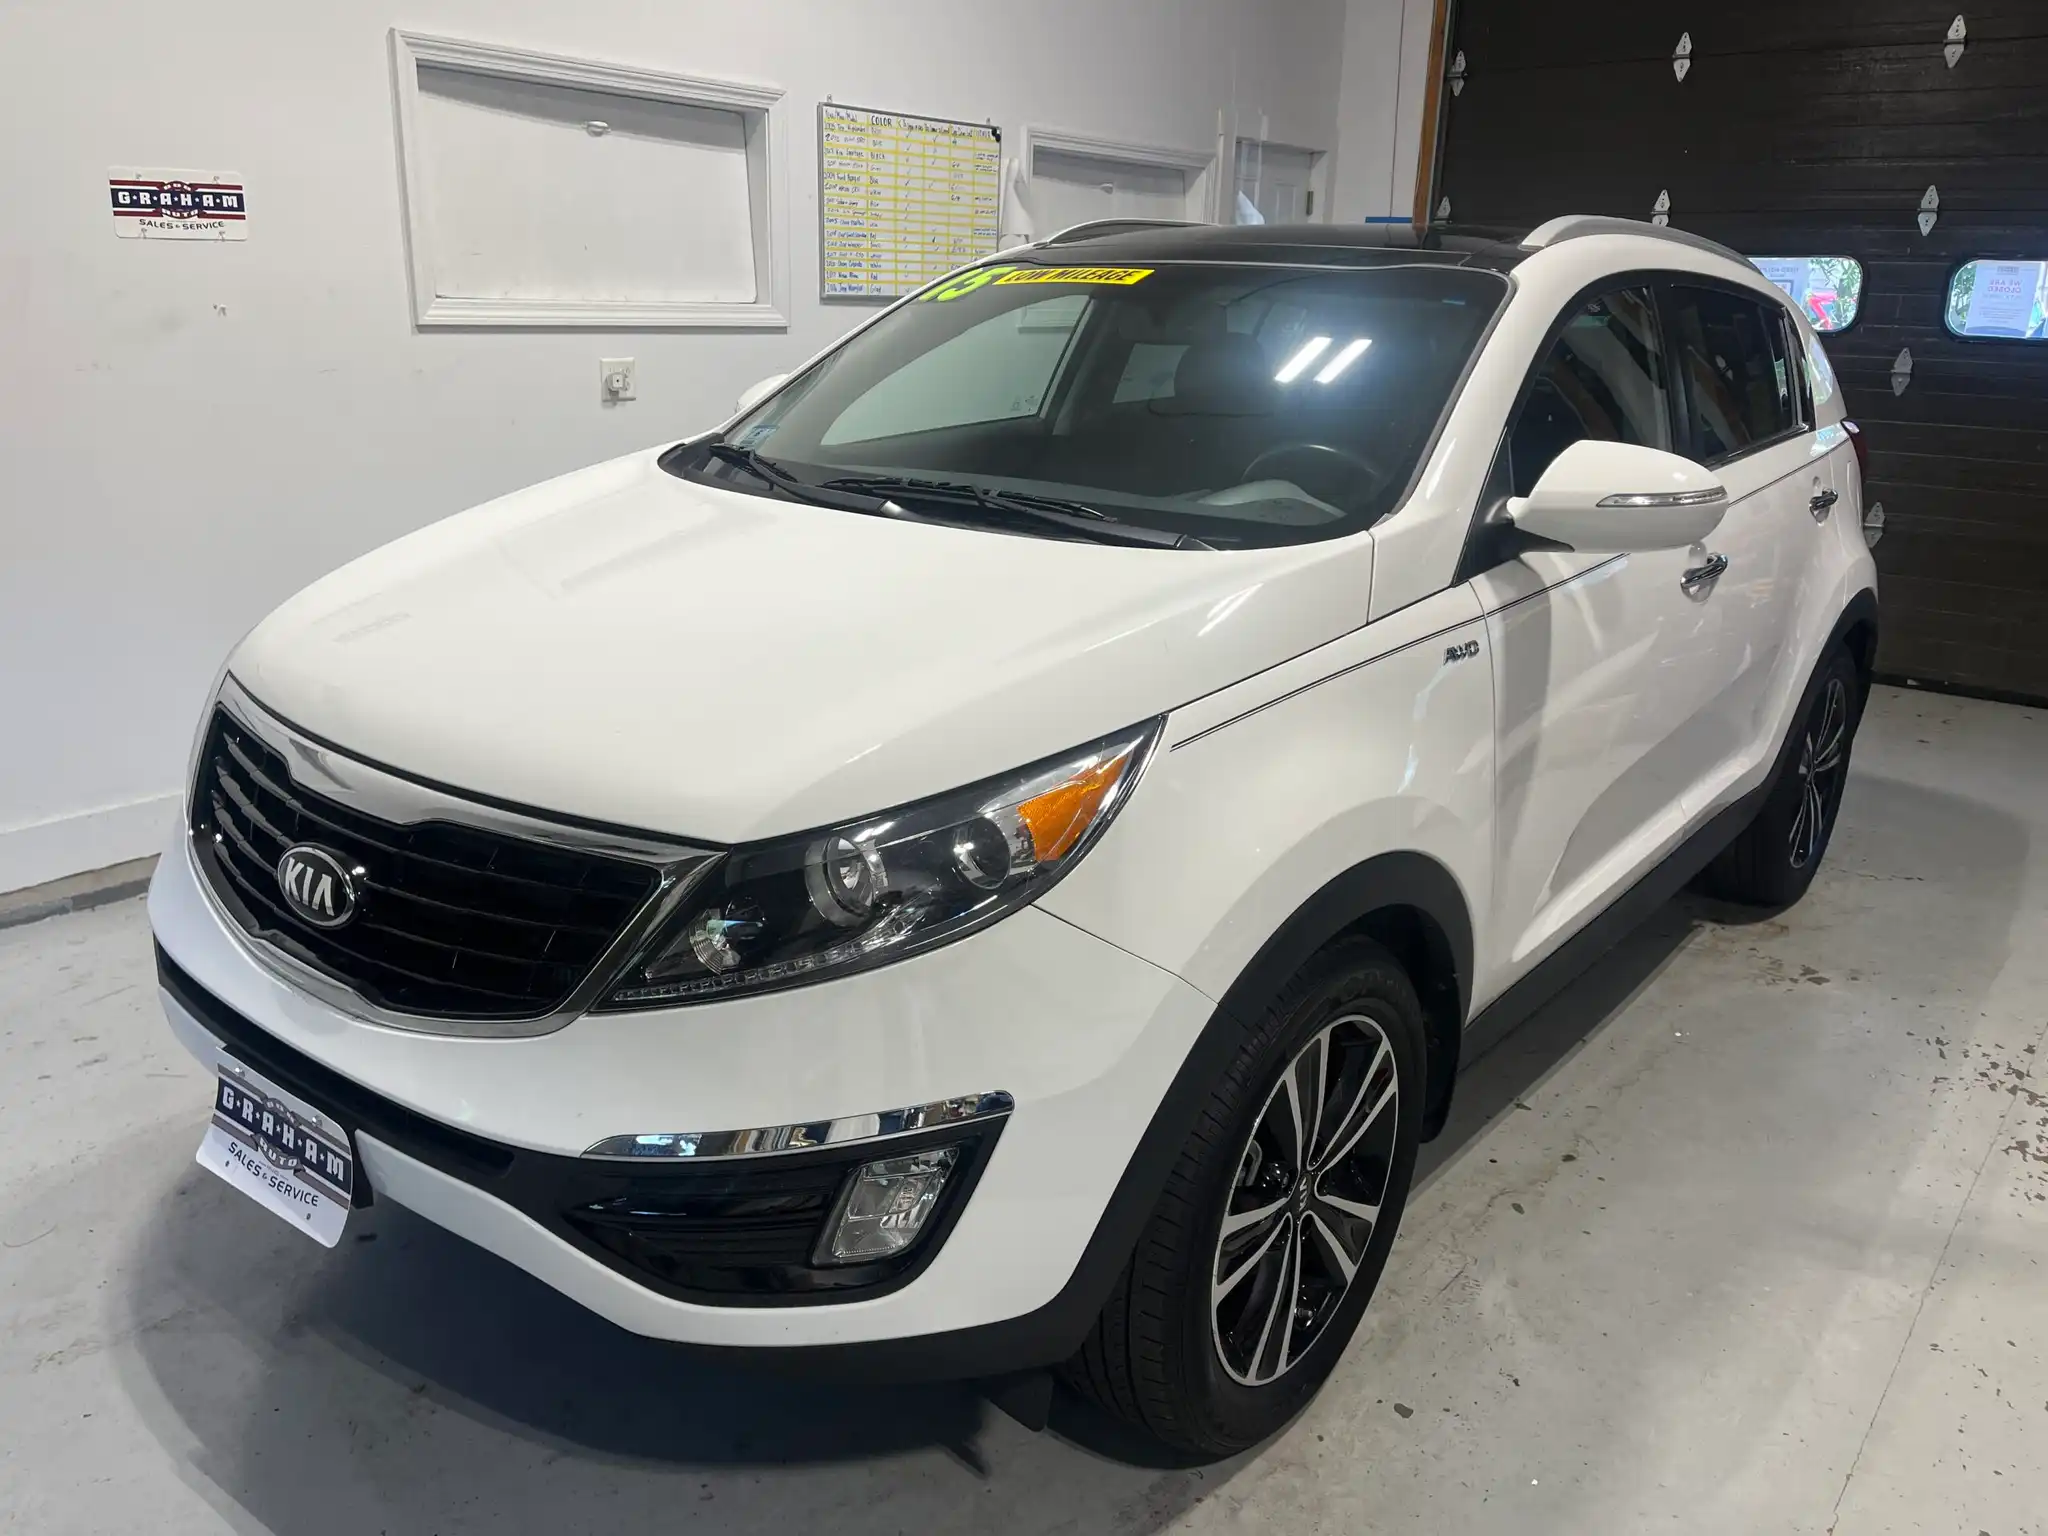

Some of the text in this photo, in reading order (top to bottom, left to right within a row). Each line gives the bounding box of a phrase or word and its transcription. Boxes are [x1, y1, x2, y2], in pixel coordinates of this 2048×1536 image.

[871, 116, 892, 127] COLOR
[161, 208, 198, 217] AUTO
[139, 219, 173, 229] SALES
[183, 221, 225, 230] SERVICE
[1006, 269, 1140, 282] LOW MILEAGE
[1443, 640, 1479, 665] AWD
[285, 857, 334, 916] KIA
[259, 1137, 299, 1167] AUTO
[229, 1141, 262, 1177] SALES
[268, 1175, 319, 1207] SERVICE
